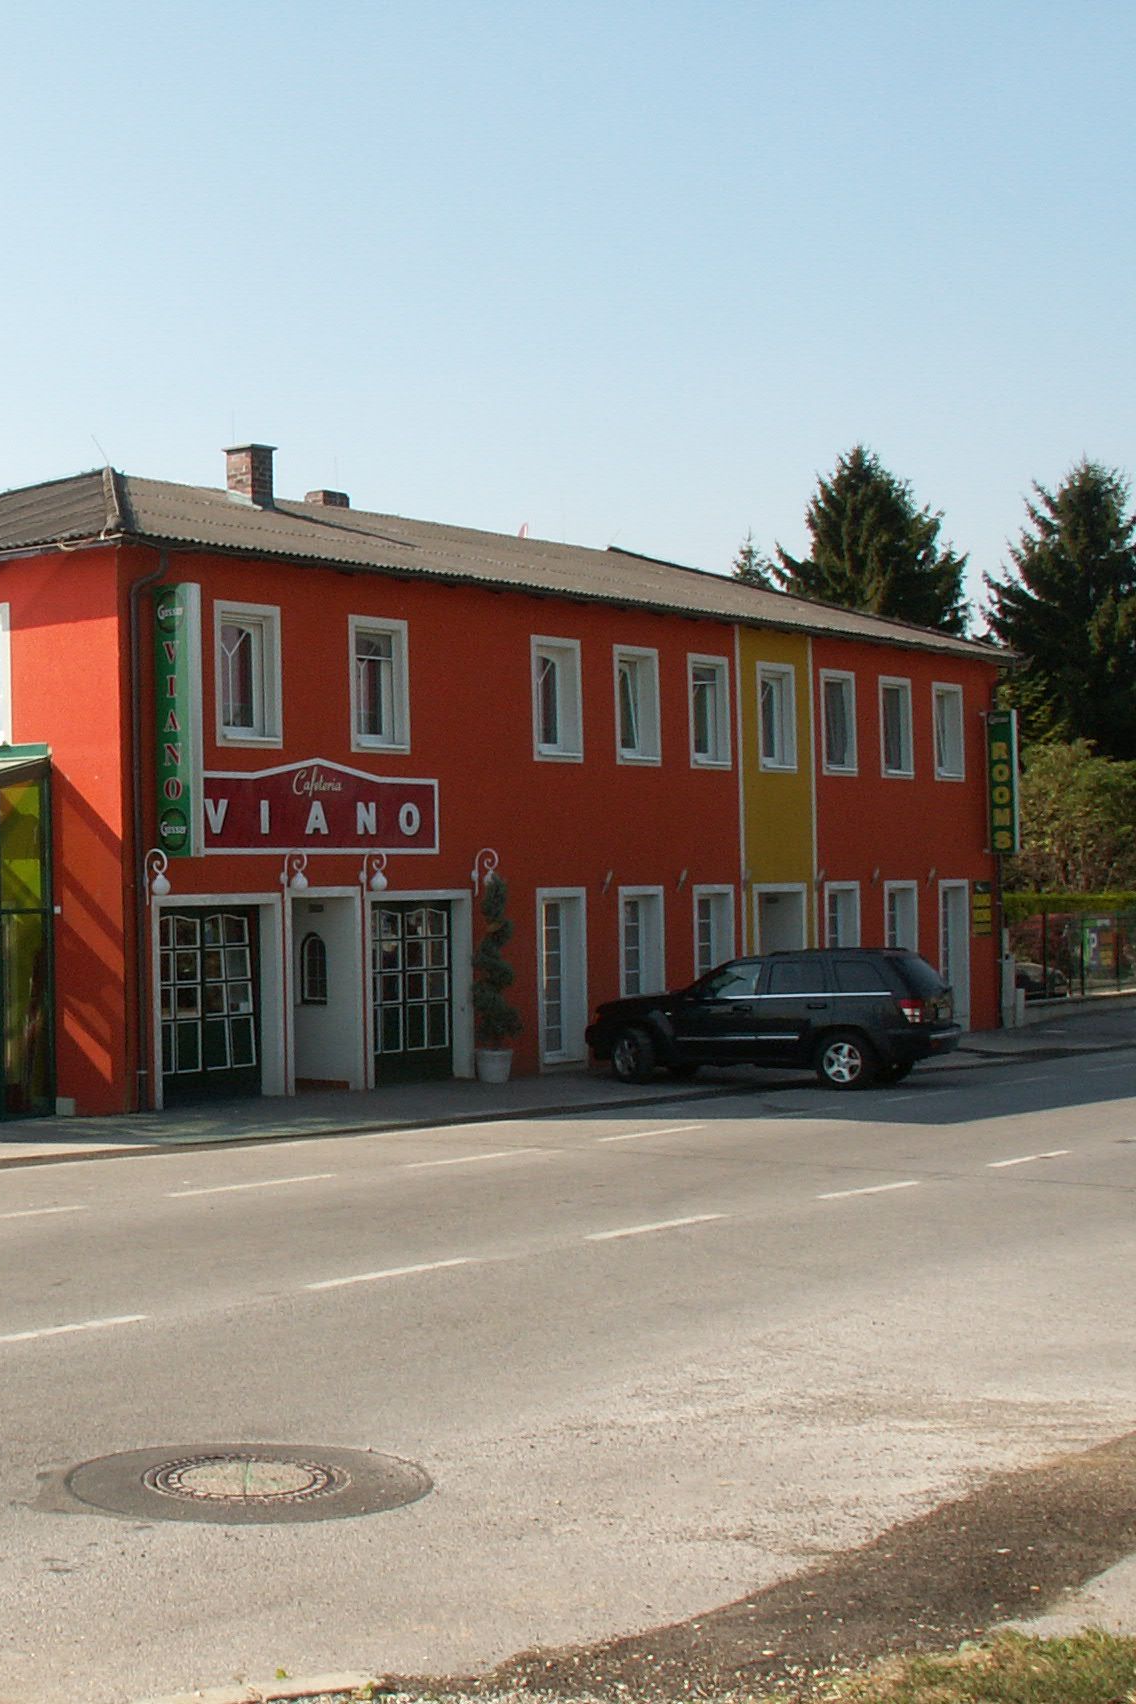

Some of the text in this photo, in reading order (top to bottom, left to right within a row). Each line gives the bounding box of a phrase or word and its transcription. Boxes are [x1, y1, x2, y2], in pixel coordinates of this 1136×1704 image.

[162, 640, 183, 800] VIANO
[204, 798, 421, 836] VIANO
[292, 766, 343, 797] Cafeteria
[991, 741, 1012, 849] ROOMS
